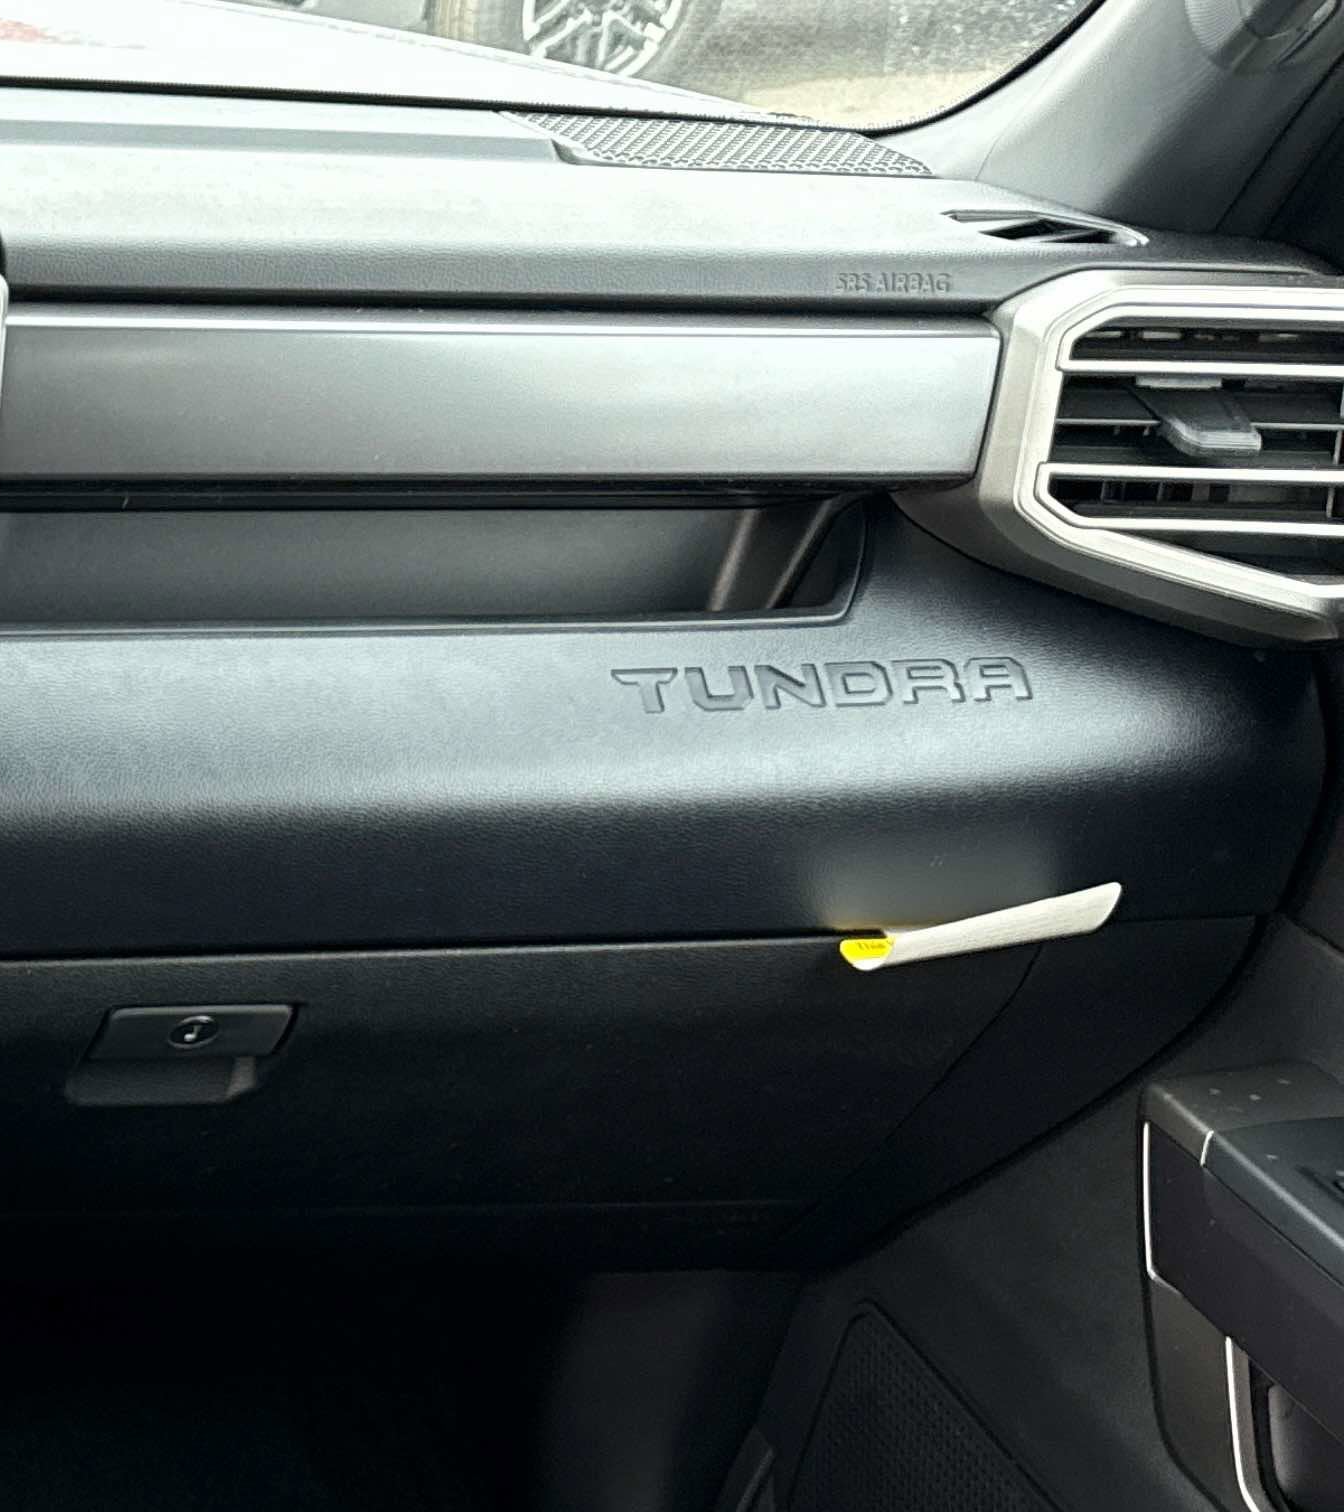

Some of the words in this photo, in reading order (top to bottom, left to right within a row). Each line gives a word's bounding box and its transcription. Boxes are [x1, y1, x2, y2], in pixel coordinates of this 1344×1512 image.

[835, 272, 873, 292] SRS
[876, 271, 952, 293] AIRBAG
[610, 655, 1034, 714] TUNDRA
